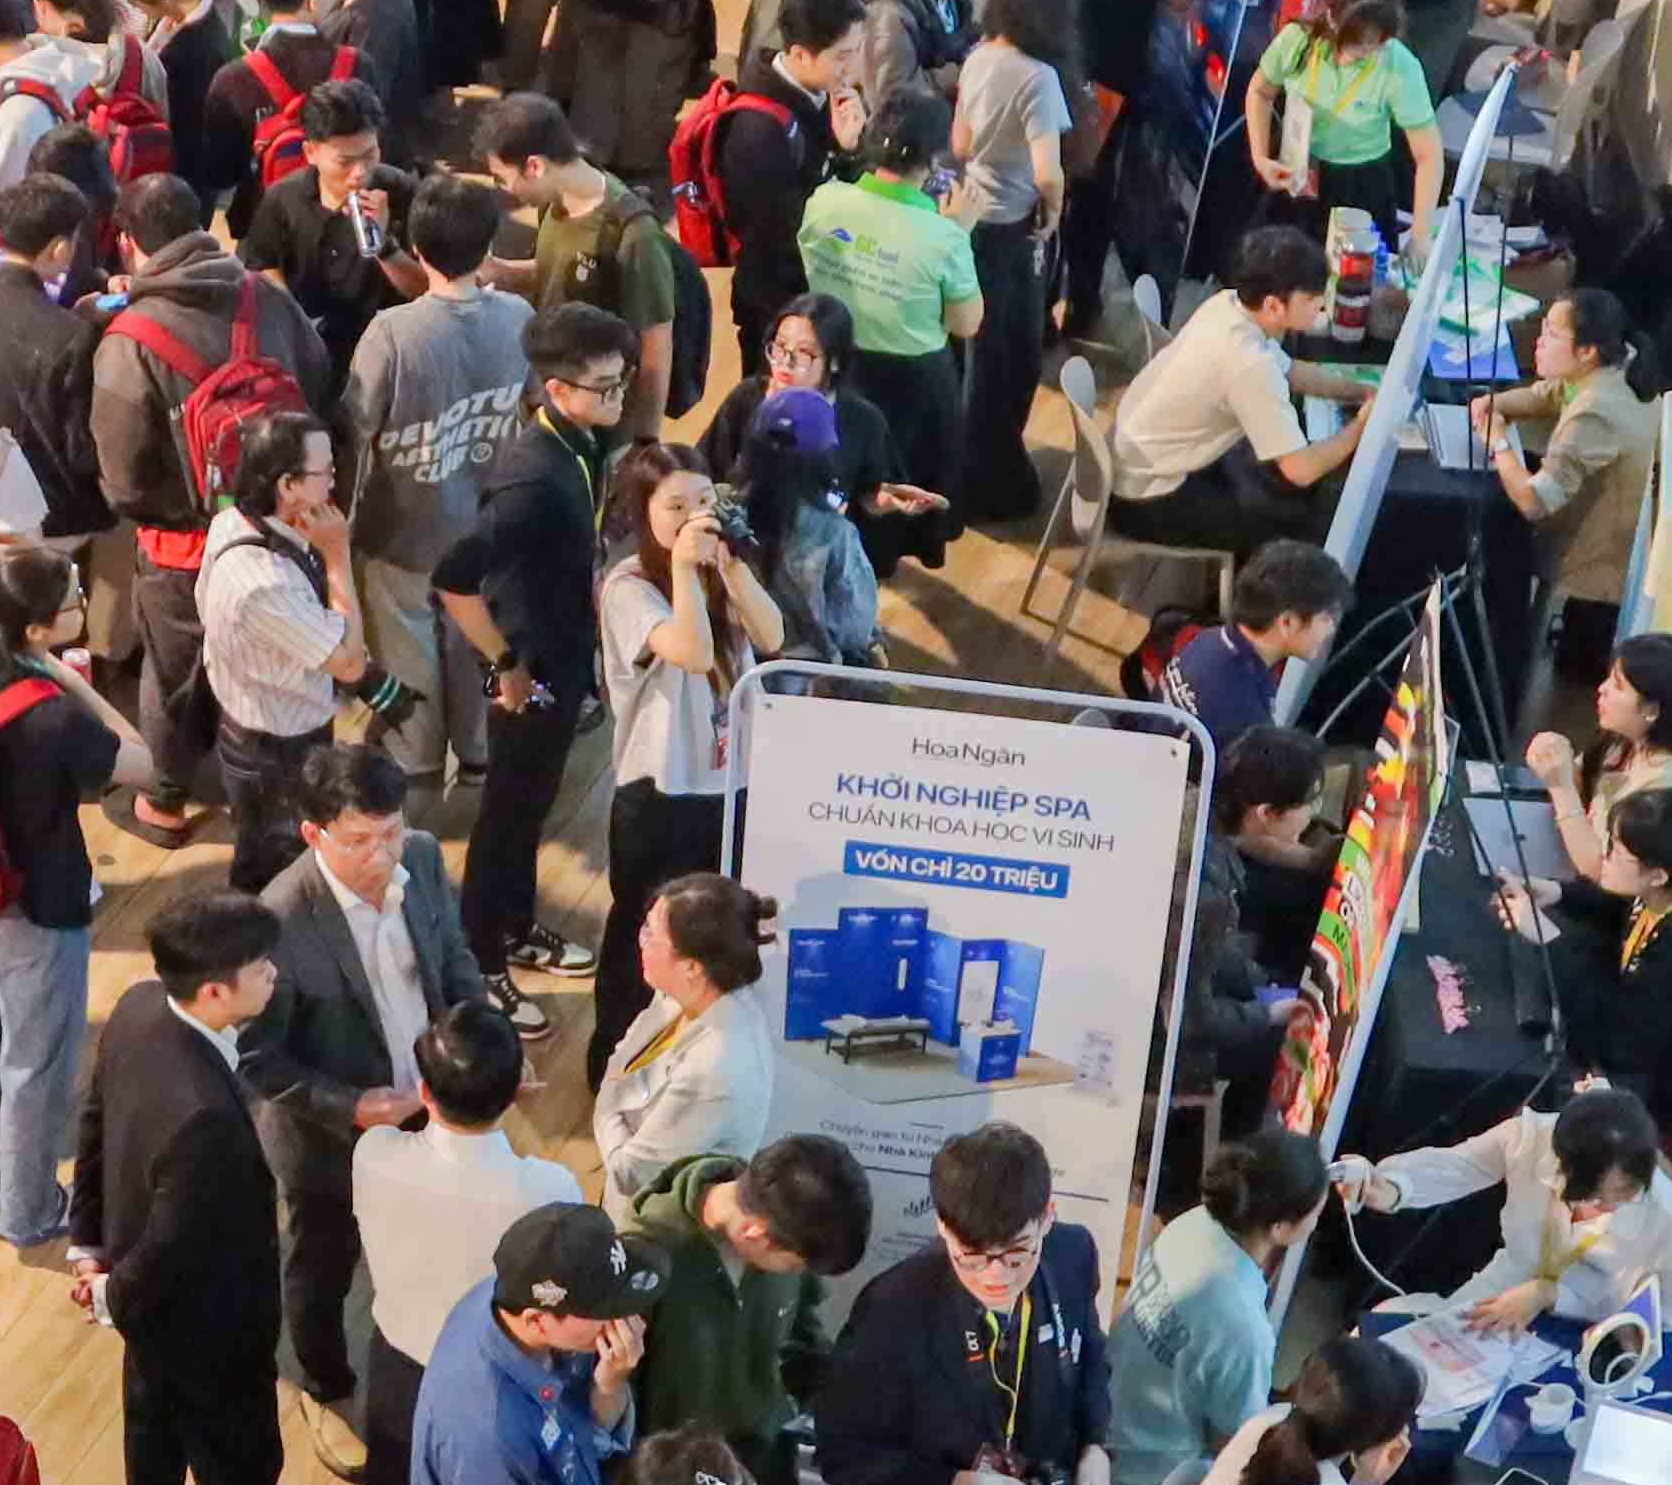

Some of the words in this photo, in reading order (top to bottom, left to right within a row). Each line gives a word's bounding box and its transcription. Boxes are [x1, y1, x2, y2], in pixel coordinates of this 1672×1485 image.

[836, 771, 909, 801] KHỞI
[917, 782, 1028, 817] NGHIỆP
[1034, 797, 1091, 821] SPA
[808, 799, 895, 828] CHUẨN
[900, 812, 968, 836] KHOA
[972, 822, 1027, 844] HỌC
[1033, 828, 1053, 846] VI
[1056, 832, 1115, 852] SINH
[855, 848, 908, 875] VỐN
[910, 855, 954, 880] CHỈ
[956, 862, 985, 881] 20
[989, 865, 1058, 892] TRIỆU
